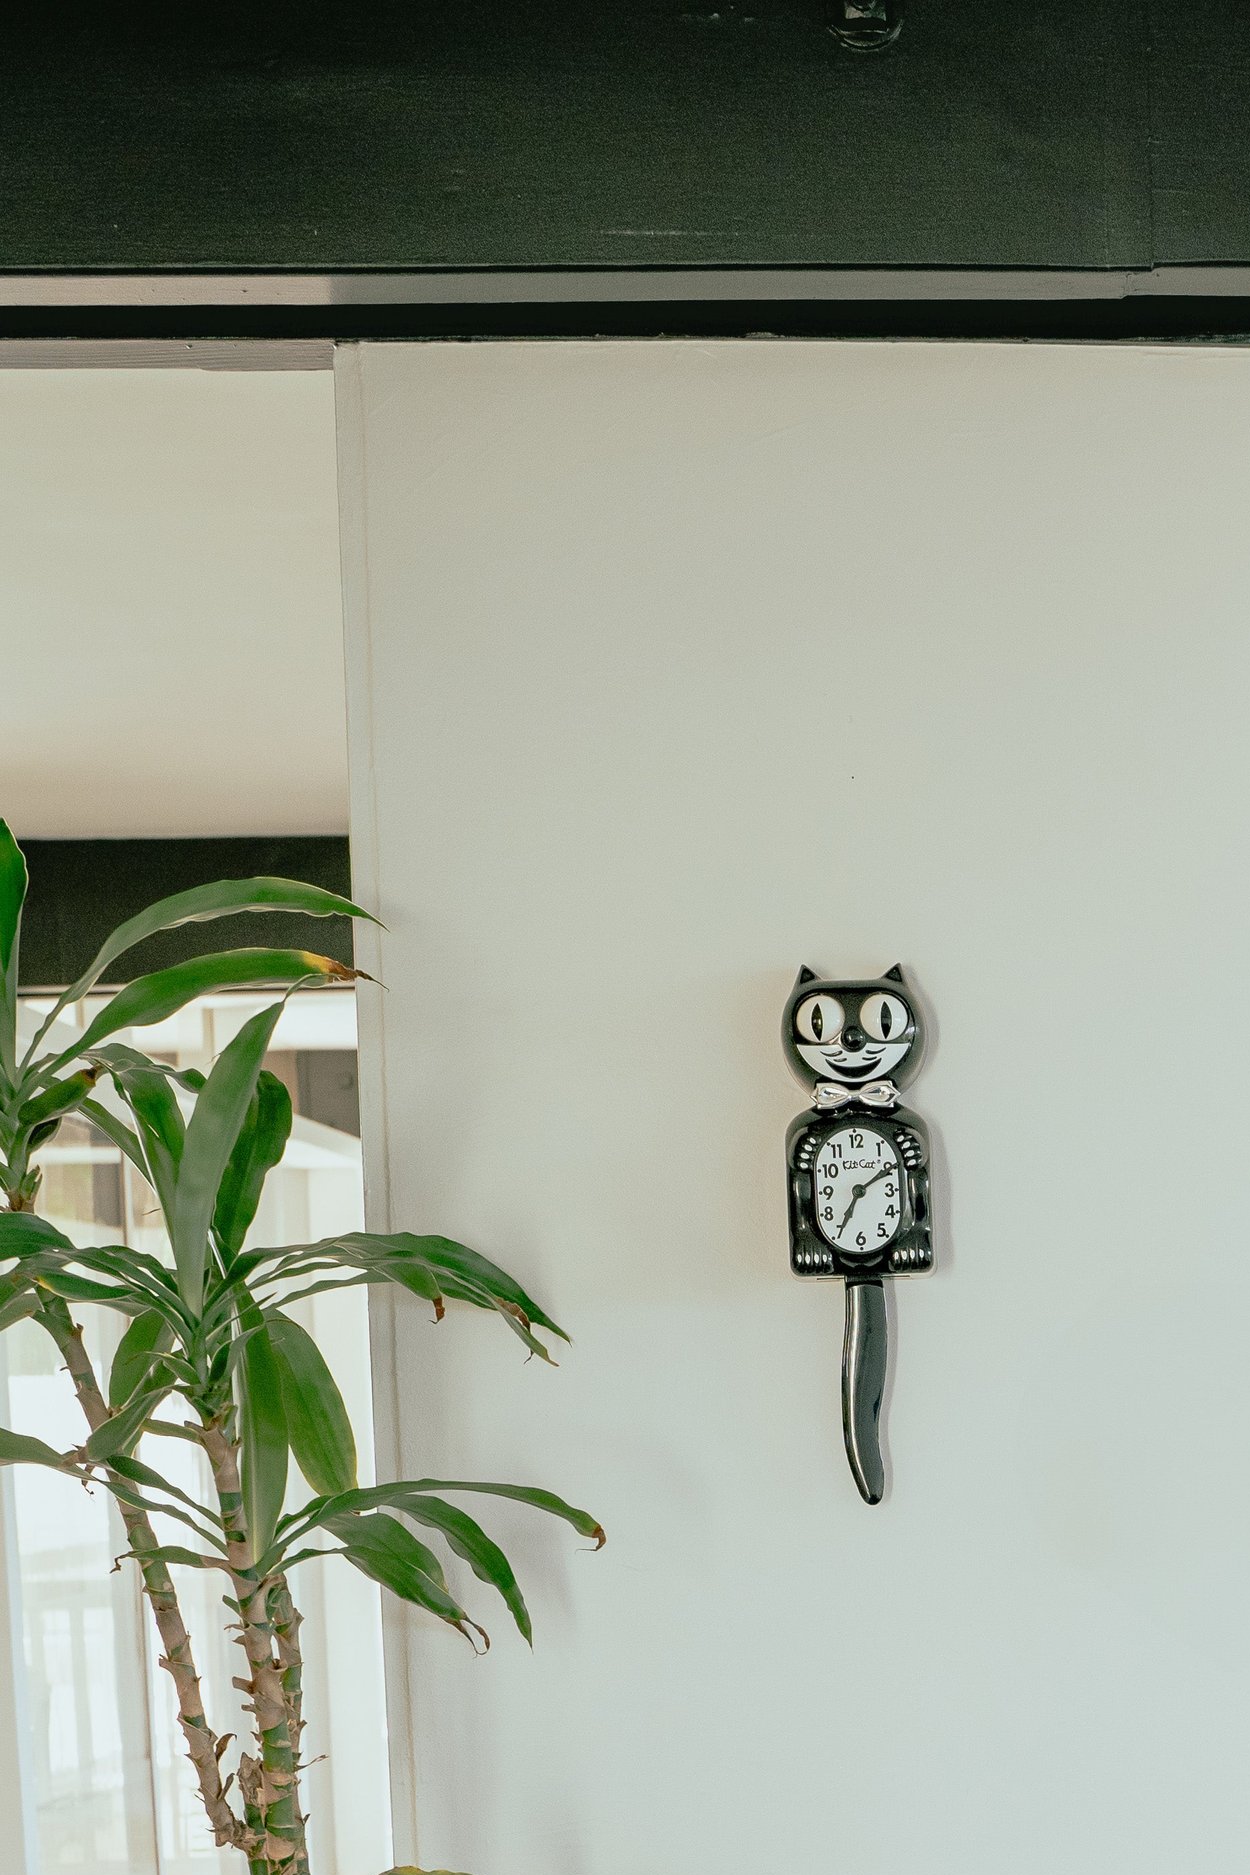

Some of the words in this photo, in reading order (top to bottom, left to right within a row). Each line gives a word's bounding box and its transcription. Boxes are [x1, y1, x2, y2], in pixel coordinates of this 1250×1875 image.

[848, 1133, 864, 1149] 12
[830, 1143, 843, 1159] 11
[875, 1142, 882, 1158] 1
[822, 1163, 839, 1179] 10
[822, 1185, 834, 1201] 9
[884, 1182, 895, 1198] 3
[823, 1205, 834, 1221] 8
[884, 1204, 896, 1219] 4
[876, 1222, 886, 1238] 5
[855, 1231, 867, 1246] 6
